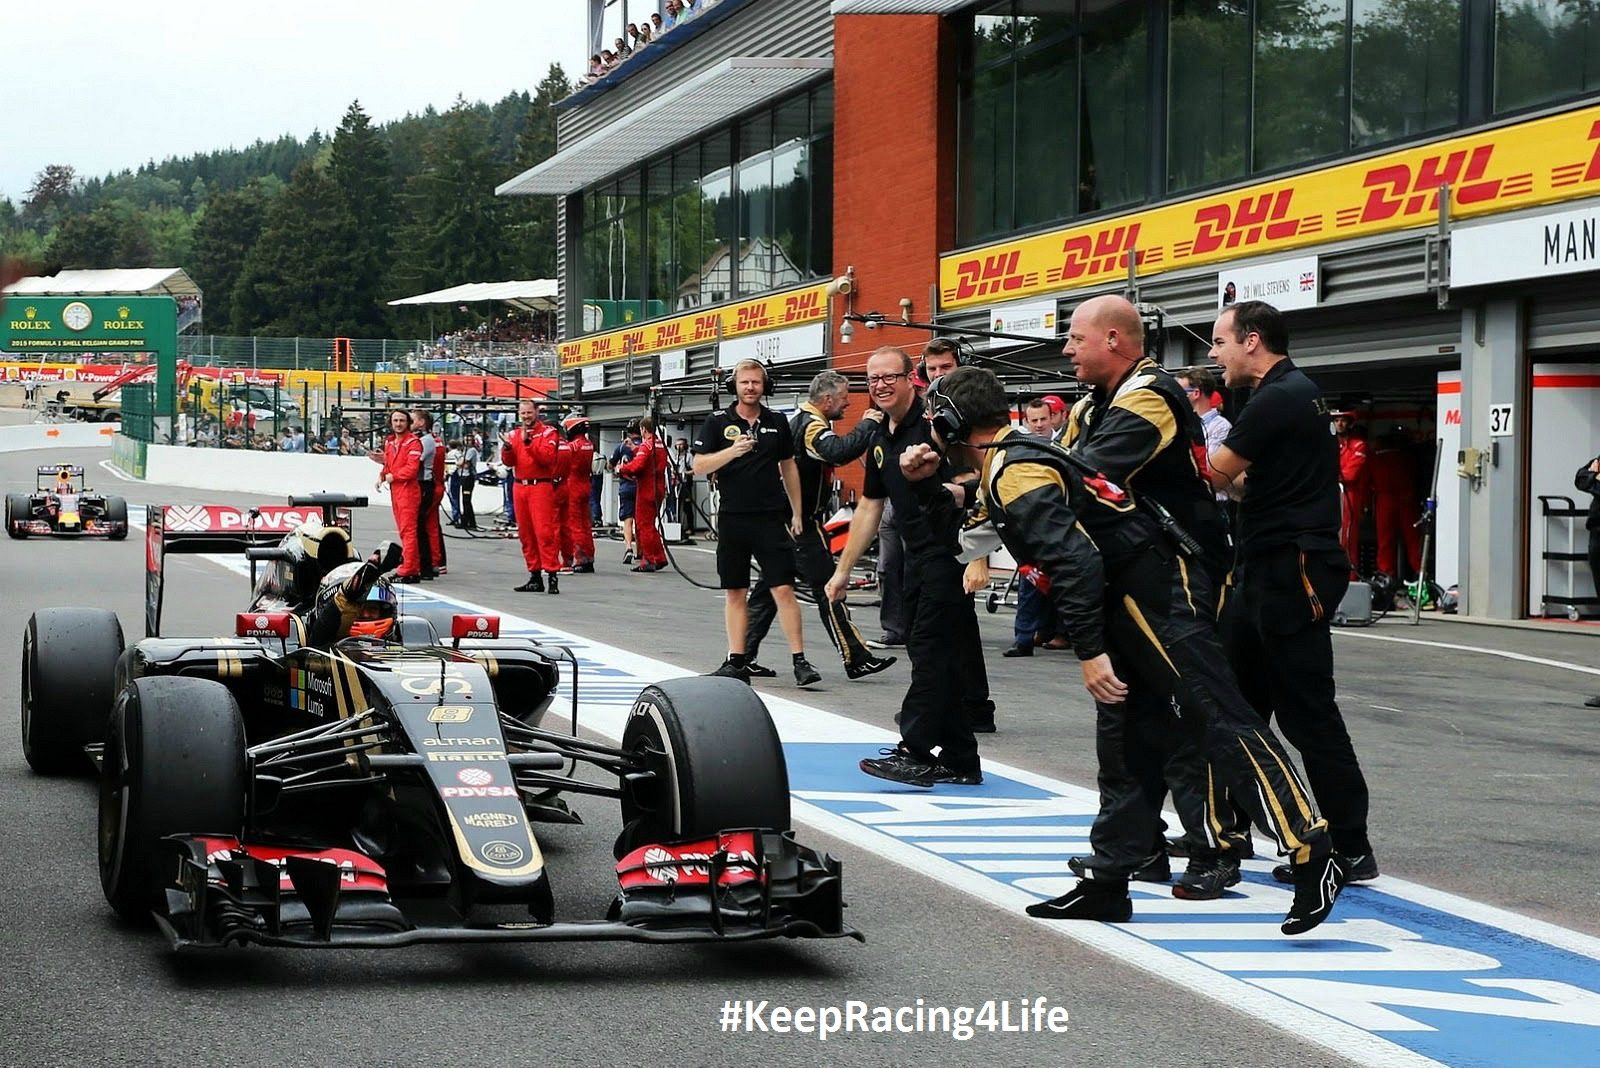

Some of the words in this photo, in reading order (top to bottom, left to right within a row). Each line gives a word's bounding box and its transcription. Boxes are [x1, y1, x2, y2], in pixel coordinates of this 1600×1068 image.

[1360, 143, 1503, 224] DHL
[1192, 188, 1301, 255] DHL
[1061, 222, 1146, 280] DHL
[956, 250, 1025, 300] DHL
[1253, 282, 1266, 297] WILL
[1266, 279, 1291, 296] STEVENS
[736, 303, 769, 331] DHL
[784, 291, 821, 322] DHL
[10, 320, 51, 330] ROLEX
[104, 320, 145, 330] ROLEX
[656, 323, 683, 345] DHL
[694, 313, 721, 340] DHL
[591, 338, 612, 360] DHL
[622, 331, 645, 354] DHL
[562, 344, 582, 364] DHL
[1490, 407, 1512, 432] 37
[220, 511, 324, 529] PDVSA
[246, 629, 277, 637] PDVSA
[467, 630, 494, 638] PDVSA
[307, 671, 333, 697] Microsoft
[307, 694, 324, 717] Lumia
[440, 708, 459, 720] 8
[442, 785, 519, 798] PDVSA
